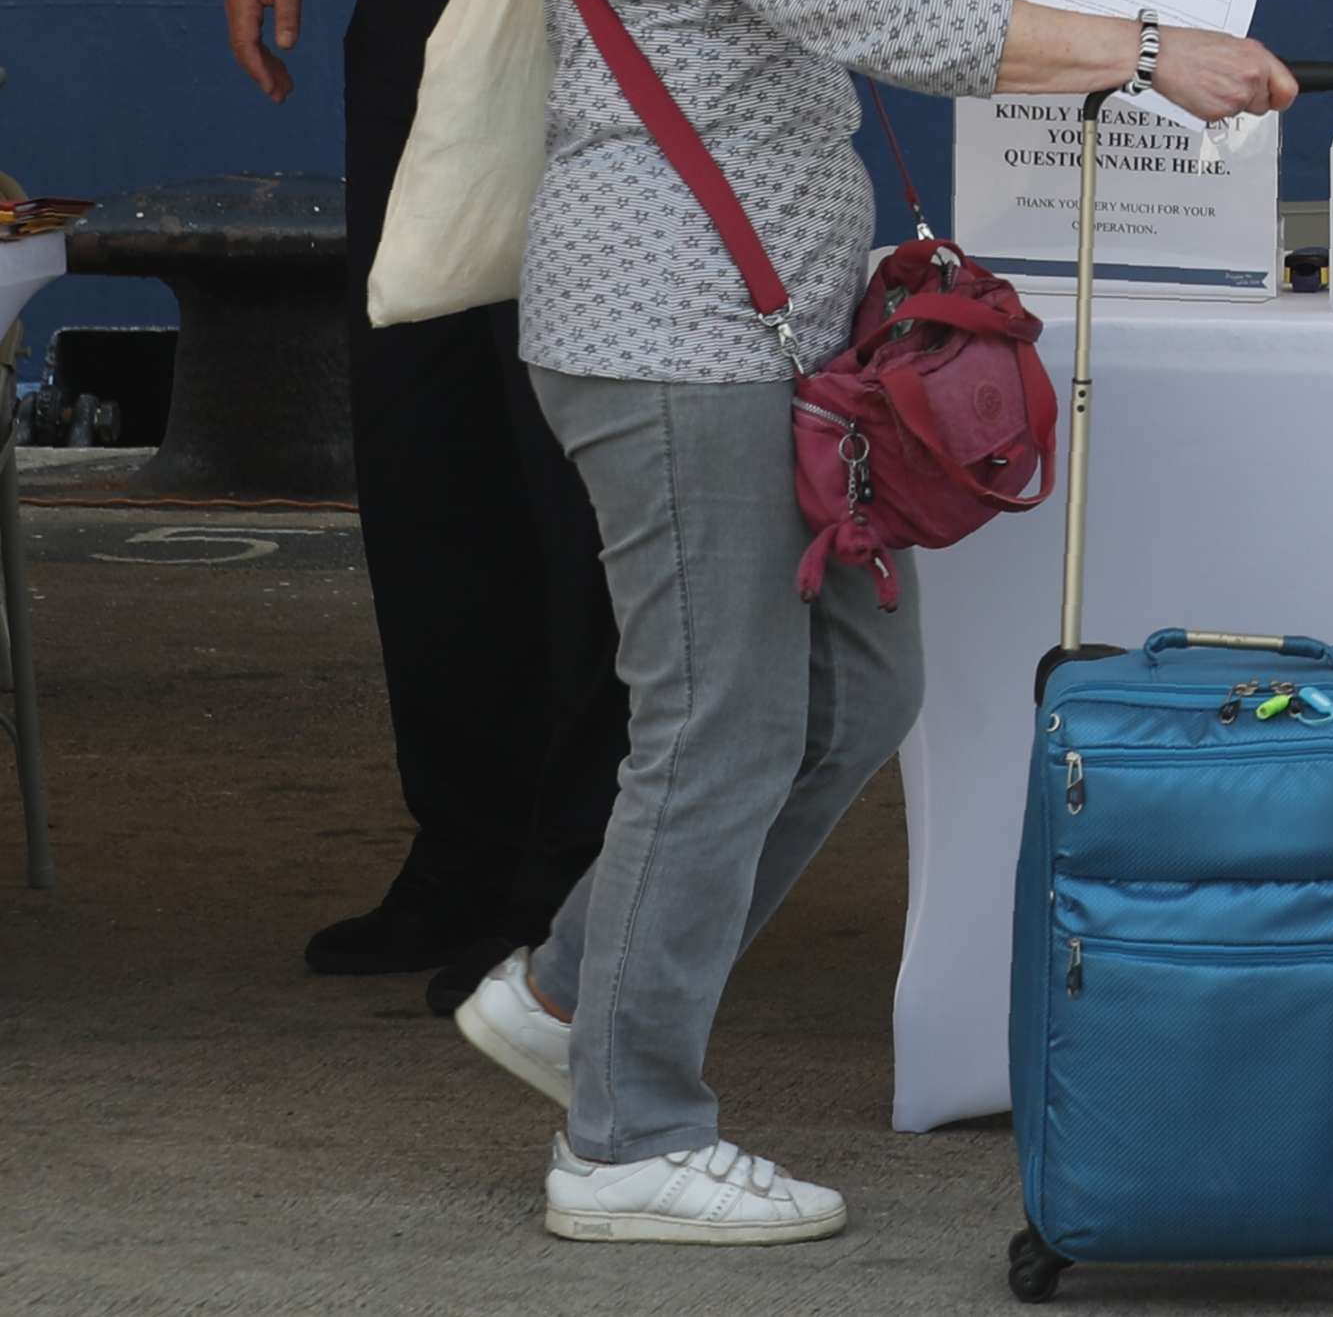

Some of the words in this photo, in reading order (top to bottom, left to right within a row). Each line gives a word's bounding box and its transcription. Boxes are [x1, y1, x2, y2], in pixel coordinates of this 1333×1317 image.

[995, 103, 1072, 122] KINDLY
[1108, 131, 1190, 151] HEALTH
[1172, 157, 1231, 175] HERE.
[1015, 196, 1056, 209] THANK
[1094, 201, 1117, 212] ERY
[1120, 201, 1155, 214] MUCH
[1157, 203, 1180, 215] FOR
[1183, 205, 1216, 217] YOUR
[1071, 220, 1158, 235] CPERATION.
